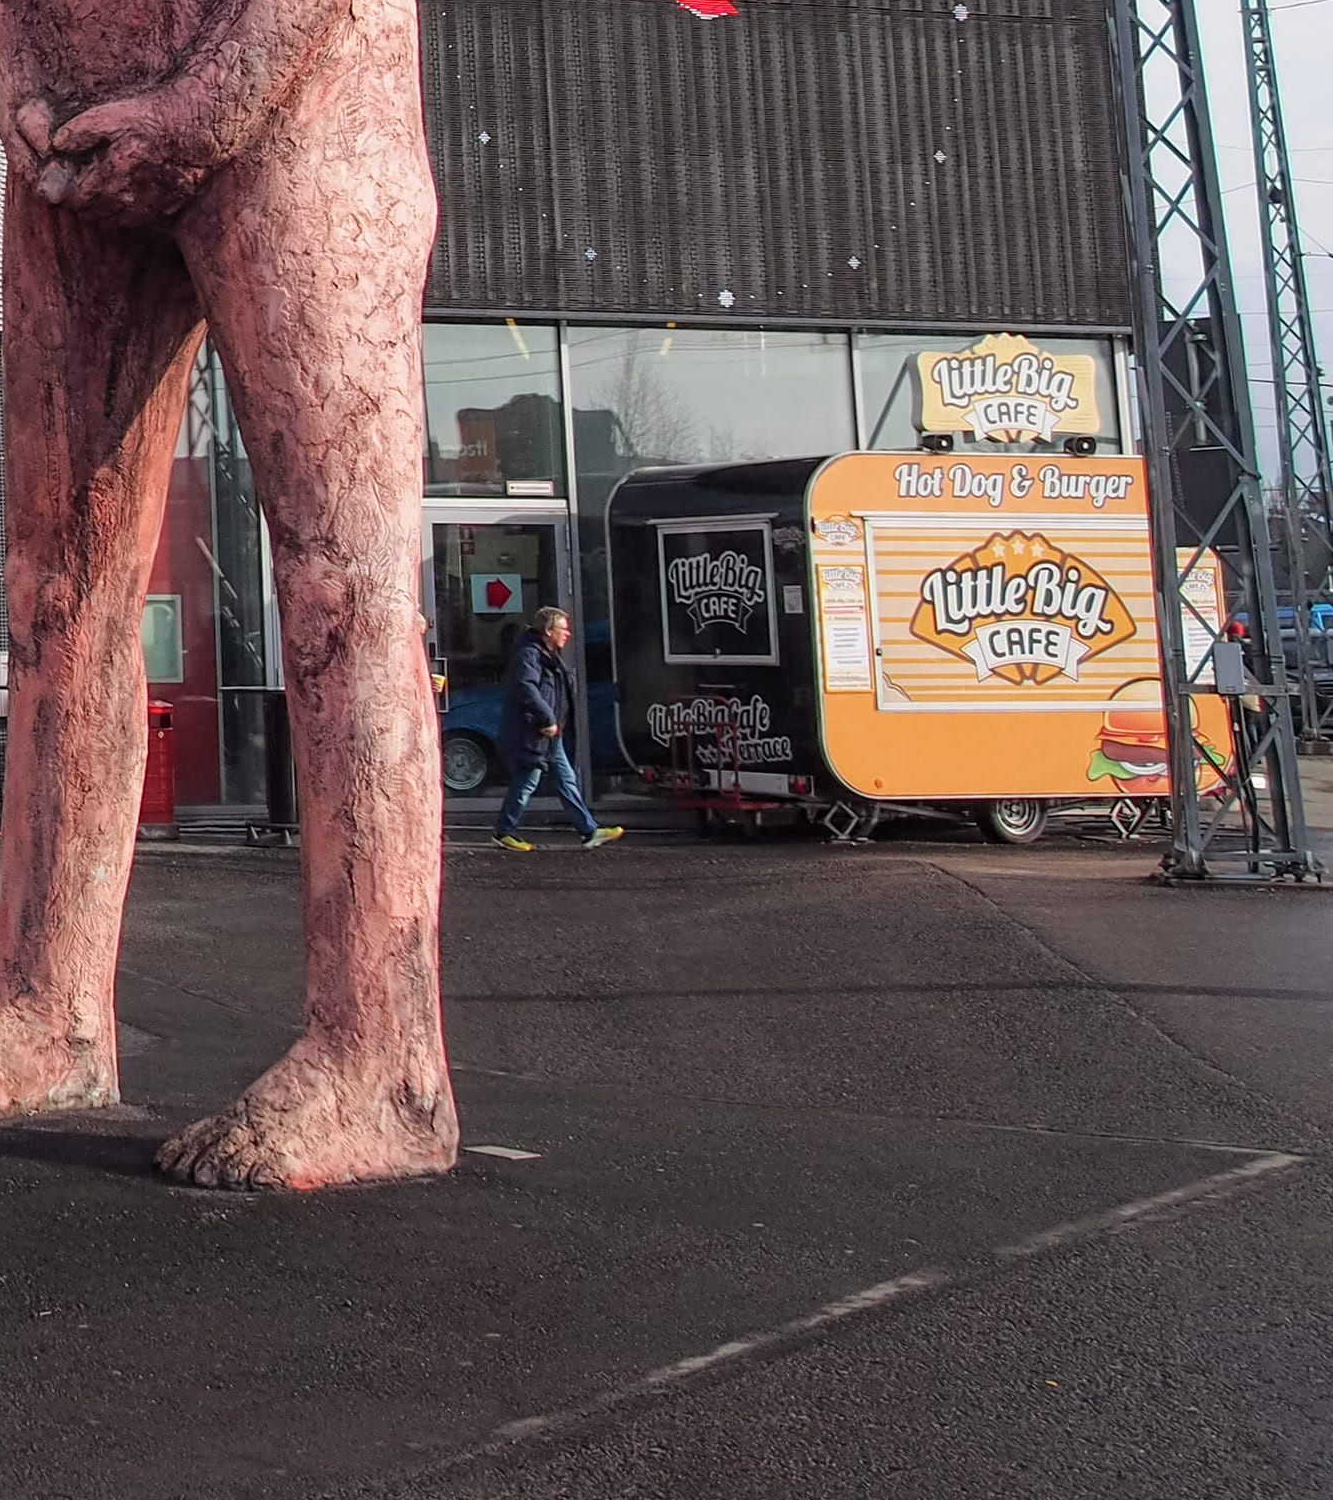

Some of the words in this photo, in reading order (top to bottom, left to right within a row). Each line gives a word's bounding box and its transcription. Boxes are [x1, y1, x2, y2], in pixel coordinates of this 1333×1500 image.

[933, 353, 1012, 407] Little
[1011, 353, 1078, 411] Big
[983, 402, 1039, 426] CAFE
[894, 463, 943, 498] Hot
[949, 463, 1004, 508] Dog
[1010, 464, 1034, 498] &
[1039, 464, 1133, 508] Burger
[669, 552, 721, 604] Little
[719, 551, 765, 605] Big
[922, 563, 1028, 636] Little
[1026, 561, 1114, 638] Big
[701, 597, 737, 618] CAFE
[988, 627, 1060, 659] CAFE
